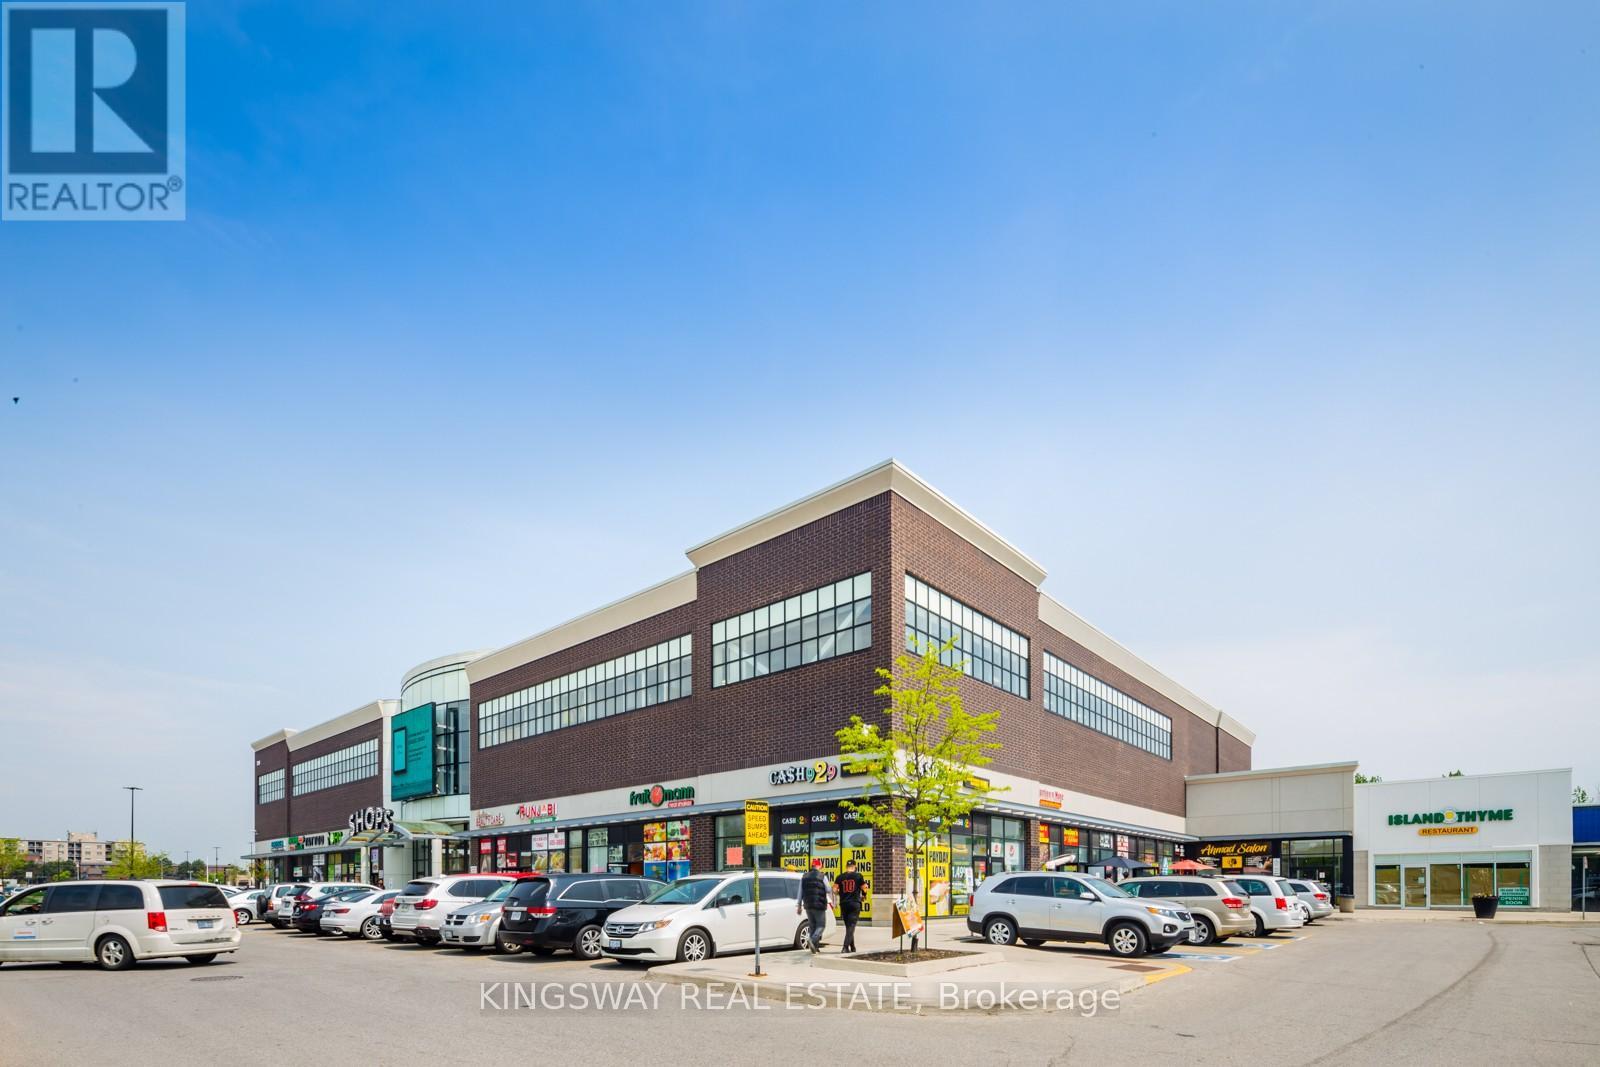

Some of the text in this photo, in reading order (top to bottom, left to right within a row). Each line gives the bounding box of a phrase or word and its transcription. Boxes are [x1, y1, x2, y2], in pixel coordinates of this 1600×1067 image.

[806, 760, 838, 784] 929
[629, 789, 652, 806] fruit
[663, 786, 695, 801] mann
[519, 802, 558, 819] PUNJABI
[747, 814, 767, 822] SPEED
[1388, 808, 1514, 826] ISLAND THYME
[348, 806, 395, 837] SHOPS
[747, 823, 767, 831] BUMPS
[747, 831, 768, 839] AHEAD
[1422, 826, 1475, 835] RESTAURANT
[782, 839, 809, 854] 1.49%
[1200, 843, 1237, 856] Ahmad
[1237, 841, 1269, 854] Salon
[851, 849, 867, 861] TAX
[842, 879, 856, 893] 10
